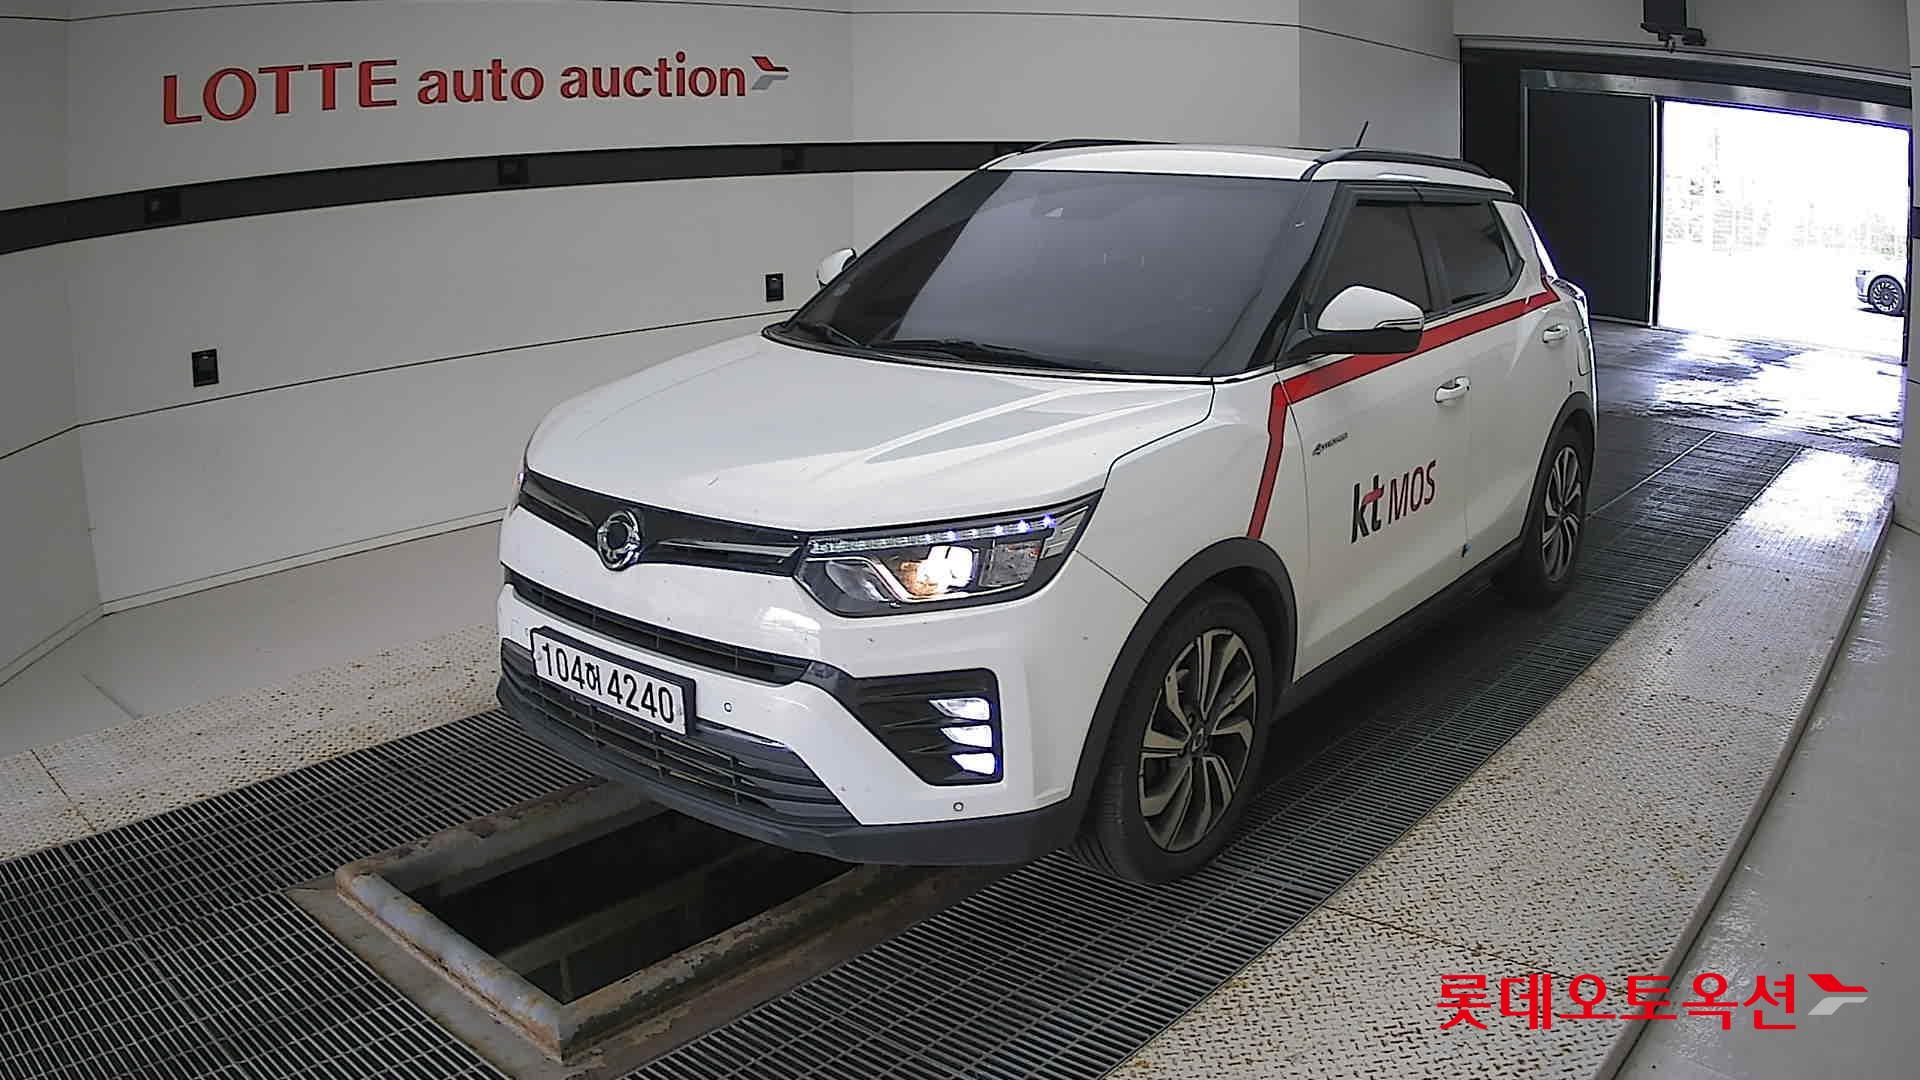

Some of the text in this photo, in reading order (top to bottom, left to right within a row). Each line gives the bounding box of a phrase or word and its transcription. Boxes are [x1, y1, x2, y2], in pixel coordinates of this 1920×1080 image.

[162, 51, 747, 126] LOTTE auto auction
[1351, 459, 1437, 544] kt MOS
[607, 669, 674, 724] 4240
